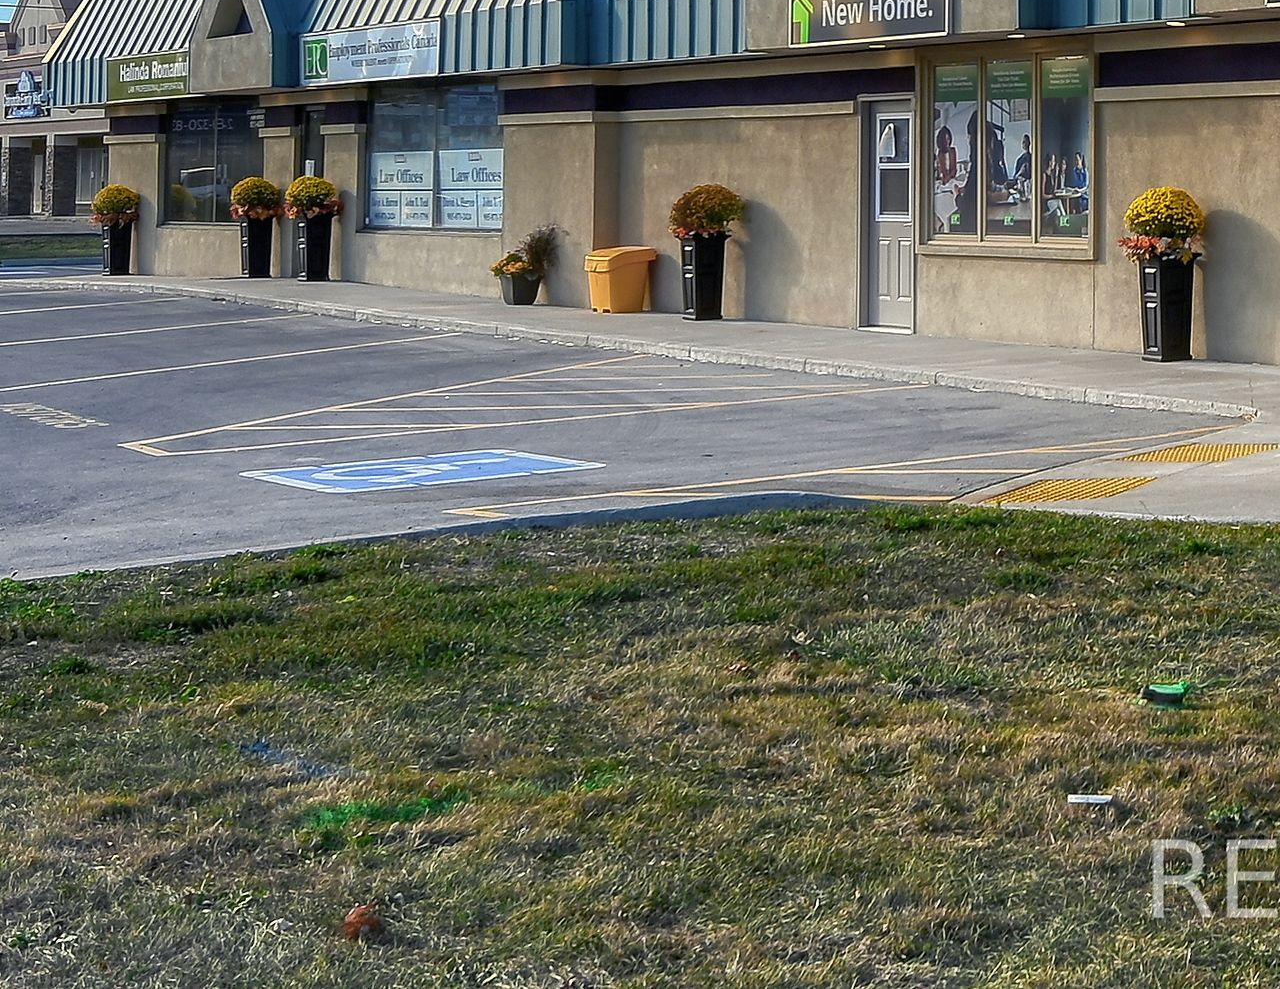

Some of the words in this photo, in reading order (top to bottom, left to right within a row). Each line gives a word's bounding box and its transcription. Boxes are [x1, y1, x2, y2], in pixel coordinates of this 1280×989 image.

[119, 60, 149, 83] Halinda
[396, 168, 424, 184] Offices
[451, 167, 470, 182] Law
[471, 166, 502, 183] Offices
